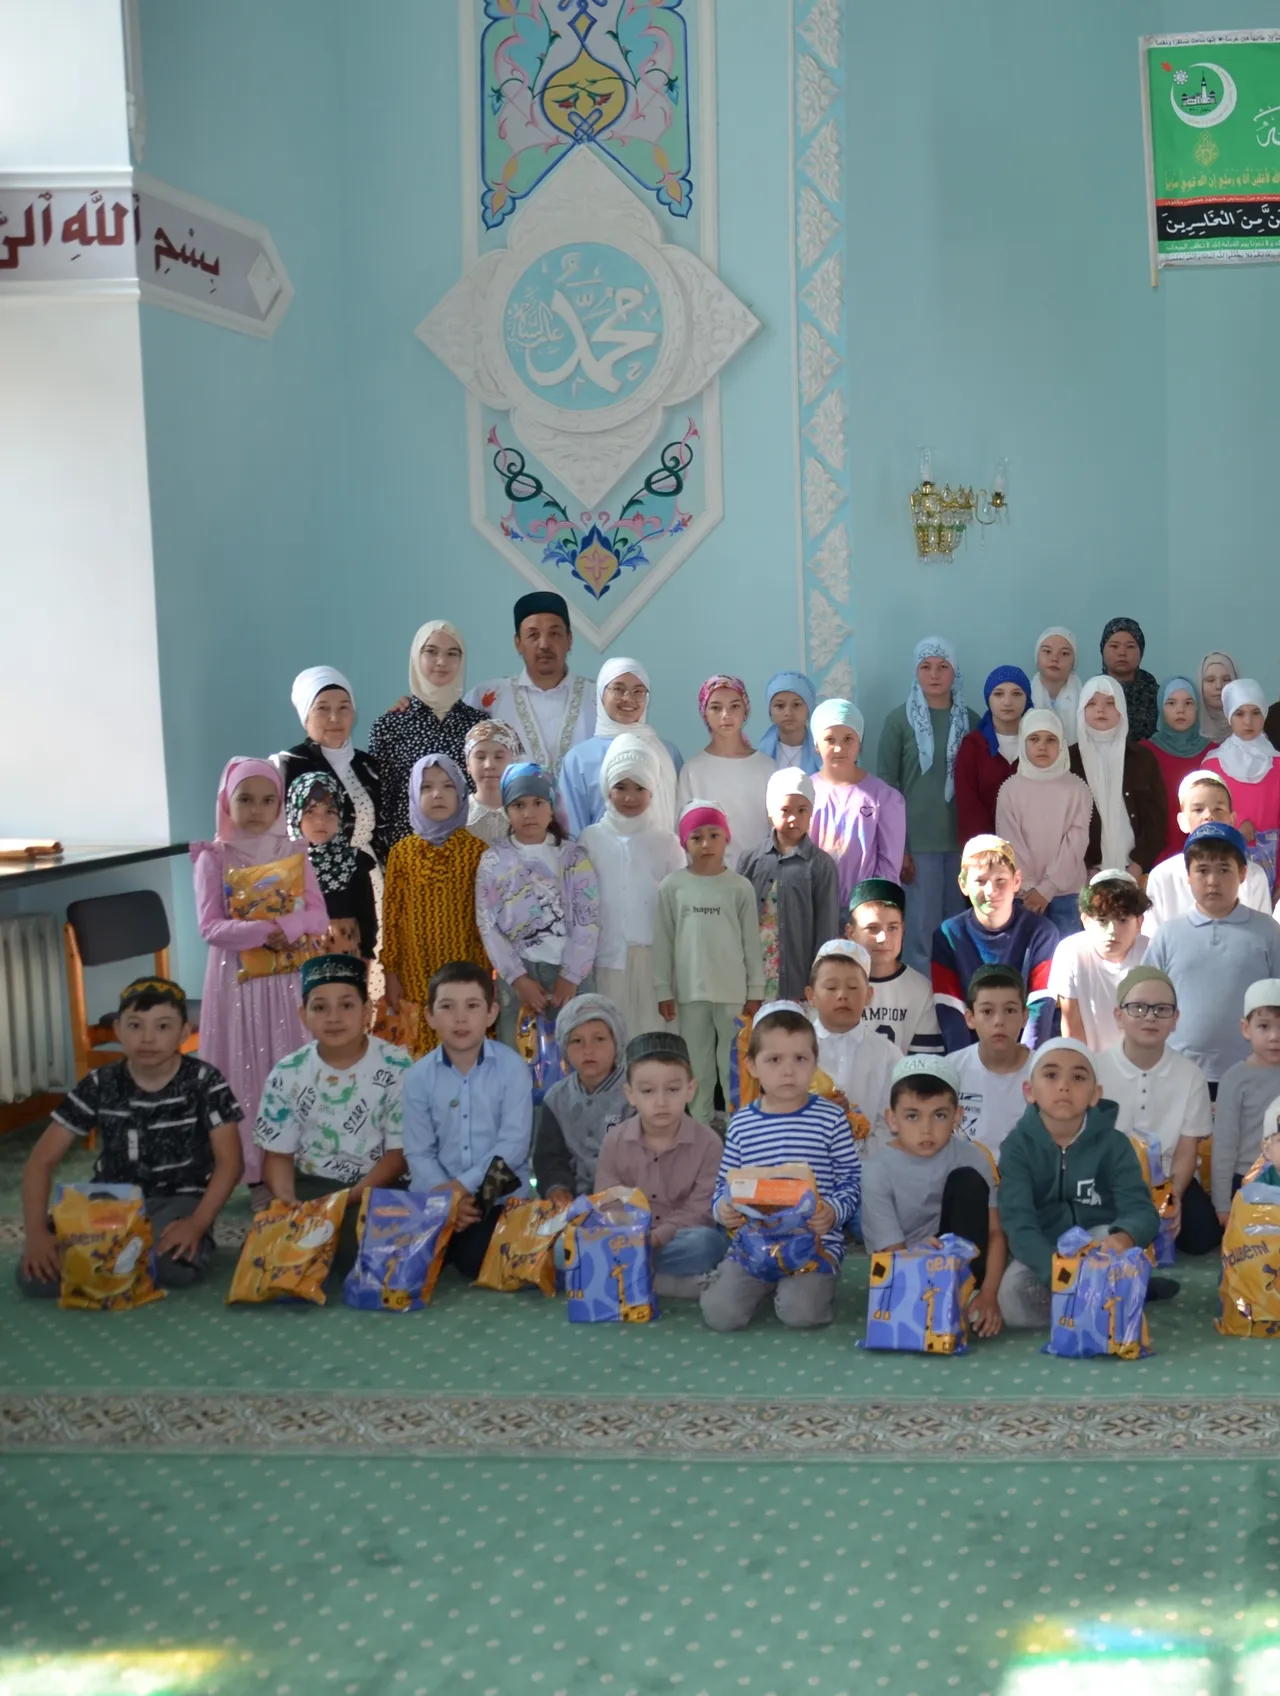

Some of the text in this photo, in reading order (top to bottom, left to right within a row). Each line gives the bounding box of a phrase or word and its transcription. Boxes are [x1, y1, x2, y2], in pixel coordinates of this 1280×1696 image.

[693, 906, 720, 915] happy
[861, 1007, 908, 1021] AMPION
[343, 1098, 370, 1135] STAR!
